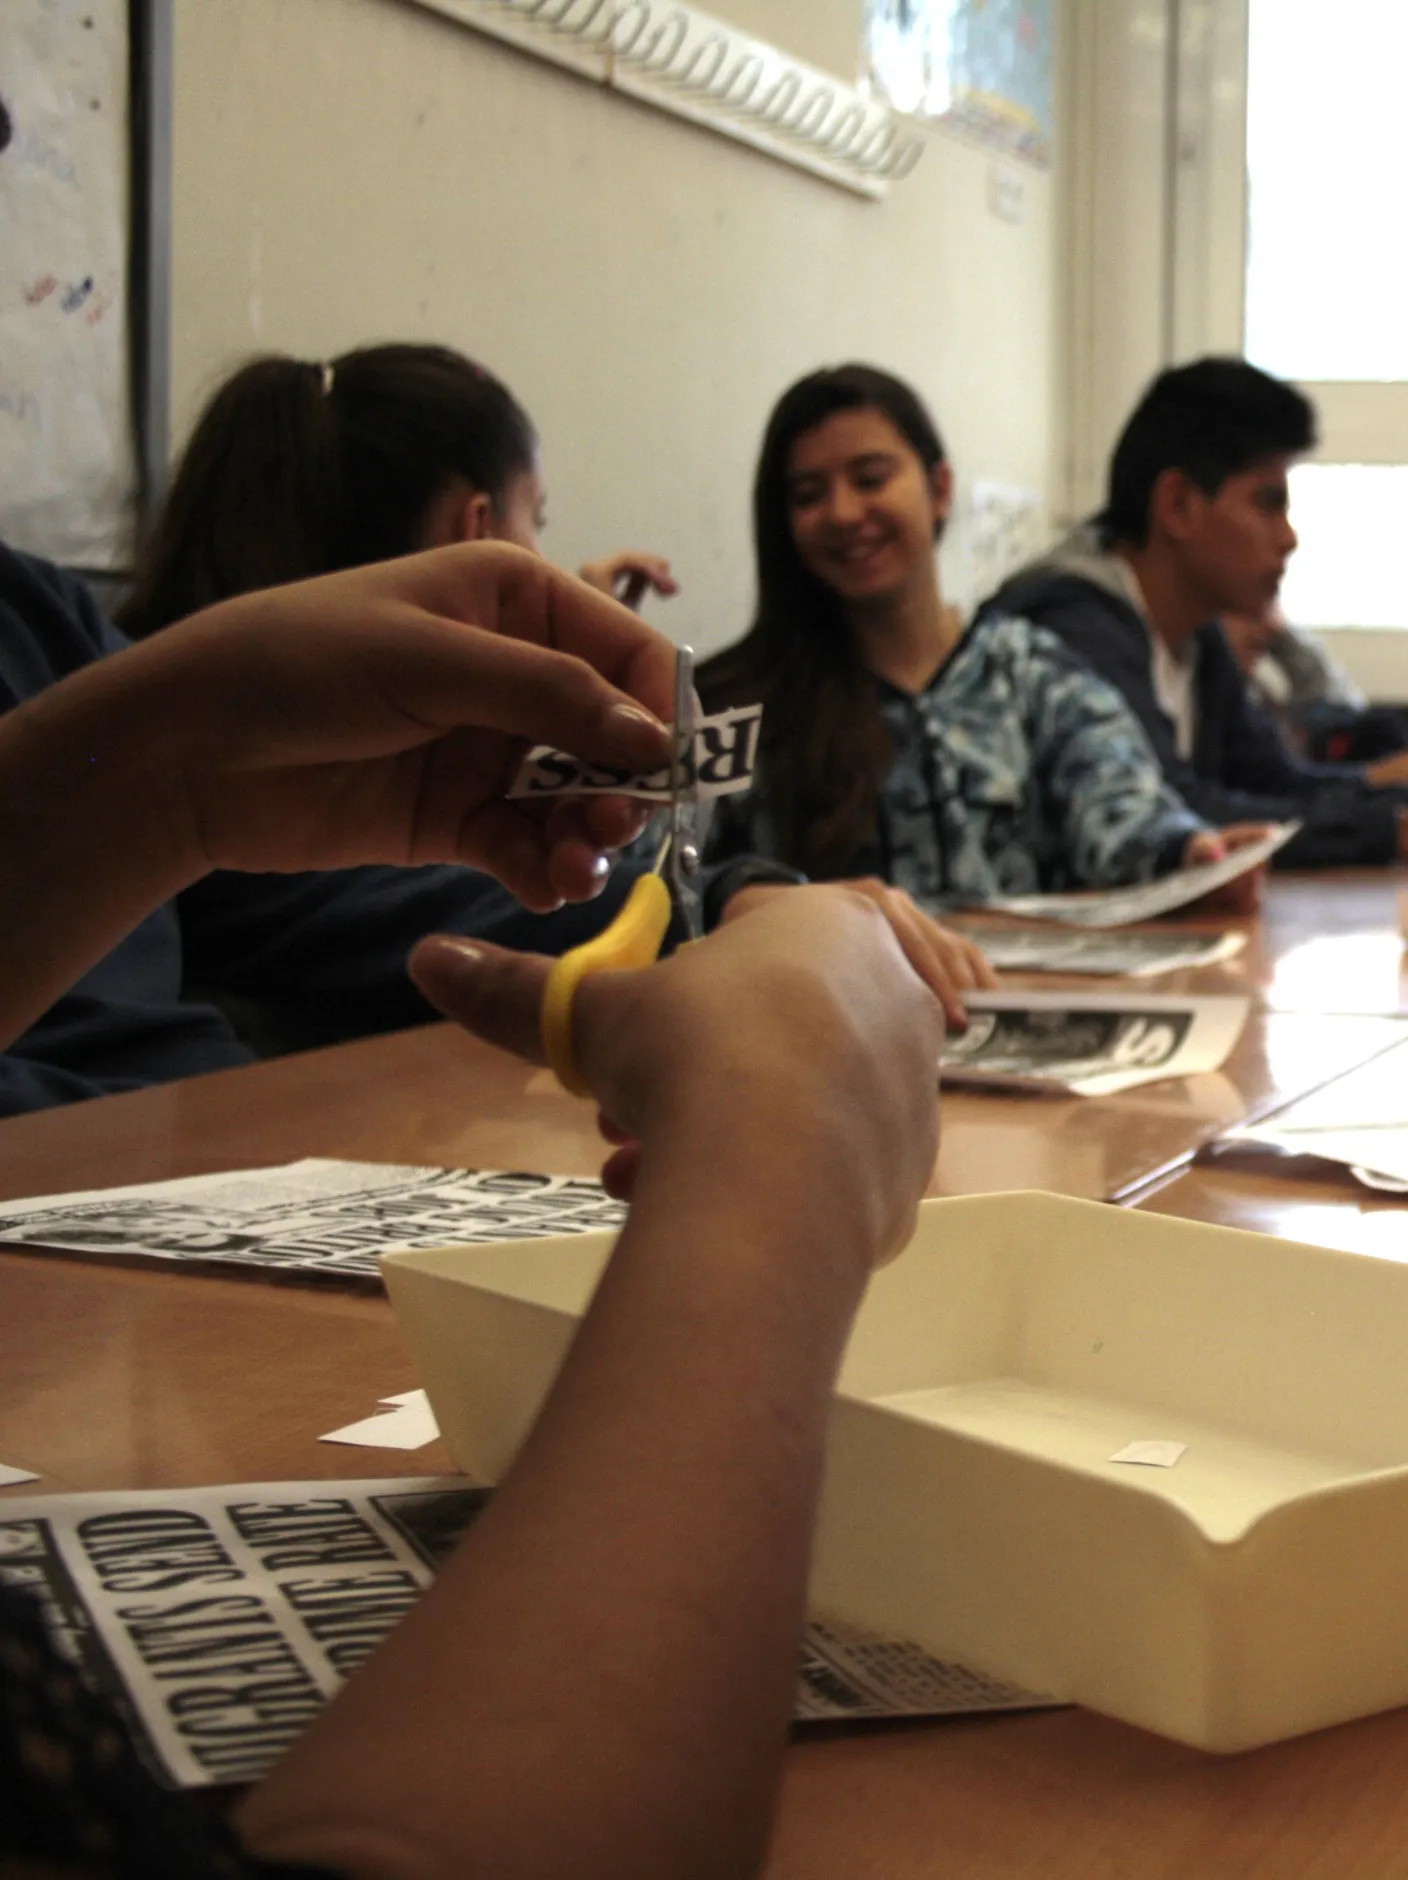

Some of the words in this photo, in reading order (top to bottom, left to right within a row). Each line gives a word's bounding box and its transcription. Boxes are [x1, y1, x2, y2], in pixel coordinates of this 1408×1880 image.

[77, 1509, 246, 1593] SEND
[226, 1498, 399, 1570] RATE
[279, 1569, 422, 1681] IME
